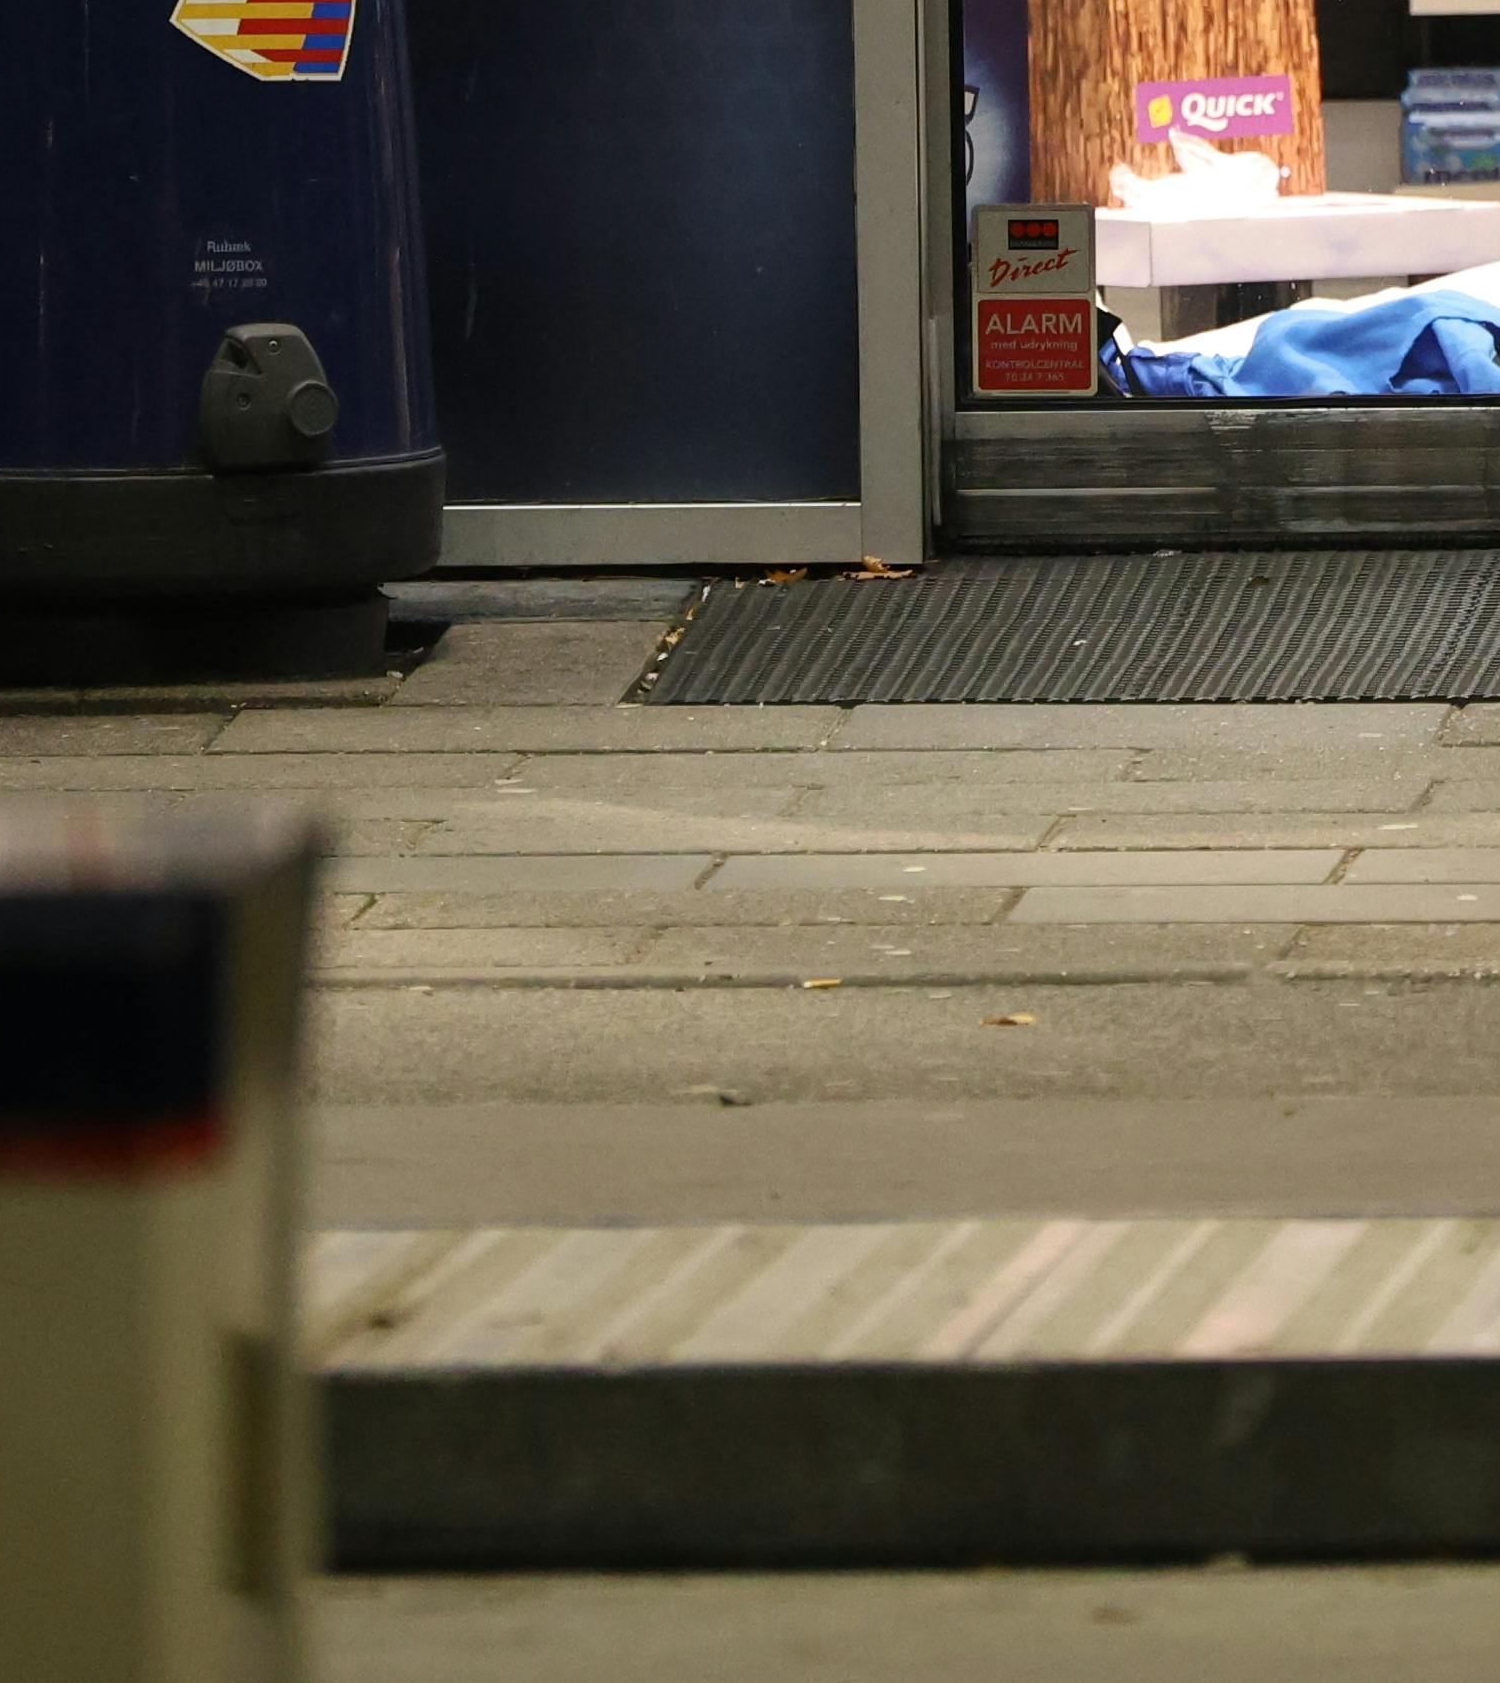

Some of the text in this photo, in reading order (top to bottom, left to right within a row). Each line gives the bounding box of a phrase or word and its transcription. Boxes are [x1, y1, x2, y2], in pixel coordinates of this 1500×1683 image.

[1181, 91, 1277, 132] QUICK
[194, 260, 263, 272] MILJØBOX
[988, 247, 1079, 288] Direct
[985, 313, 1082, 335] ALARM
[991, 339, 1078, 352] med udrykning
